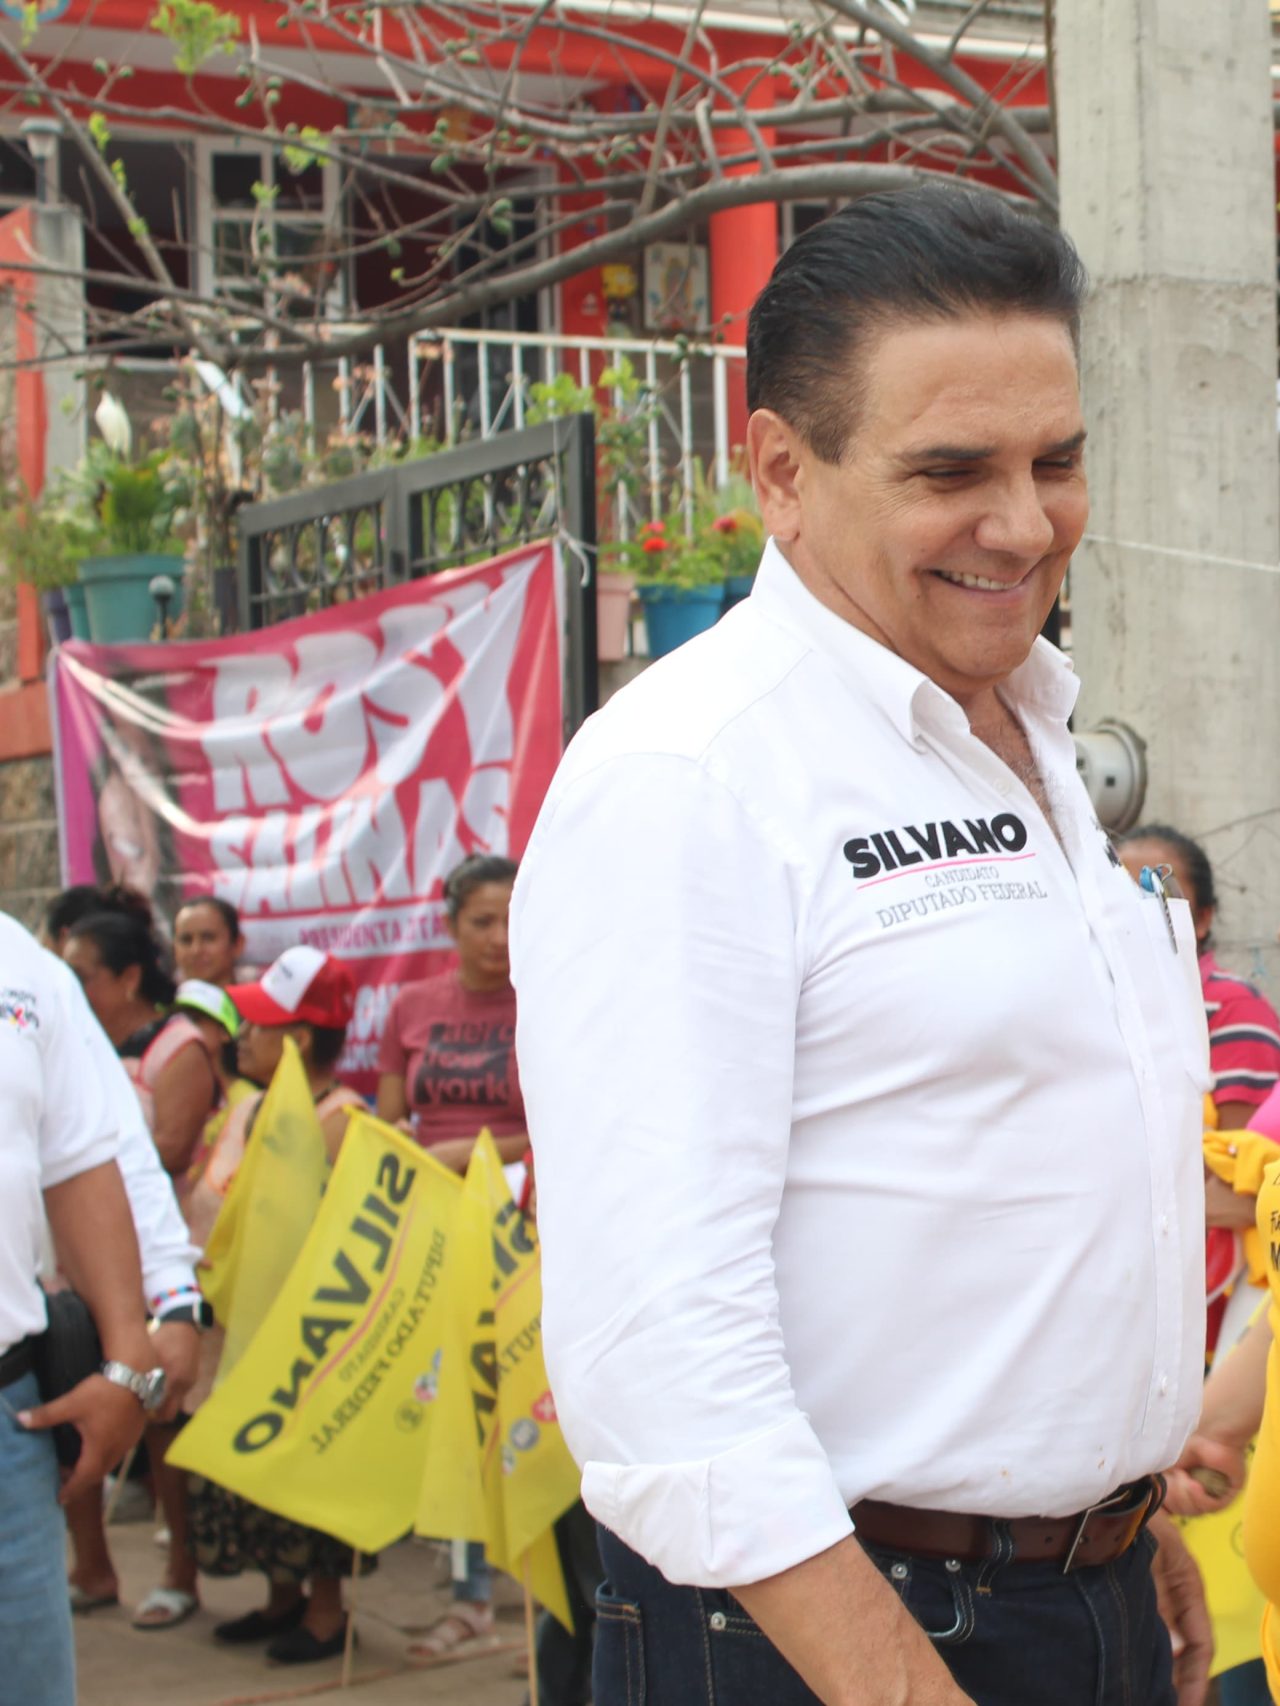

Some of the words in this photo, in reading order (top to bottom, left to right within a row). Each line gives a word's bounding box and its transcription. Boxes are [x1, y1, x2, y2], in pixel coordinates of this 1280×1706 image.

[198, 555, 545, 814] ROSY
[207, 768, 512, 914] SALINAS
[843, 813, 1028, 879] SILVANO
[876, 885, 977, 929] DIPUTADO
[977, 880, 1049, 901] FEDERAL
[924, 865, 1000, 888] CANDIDATO
